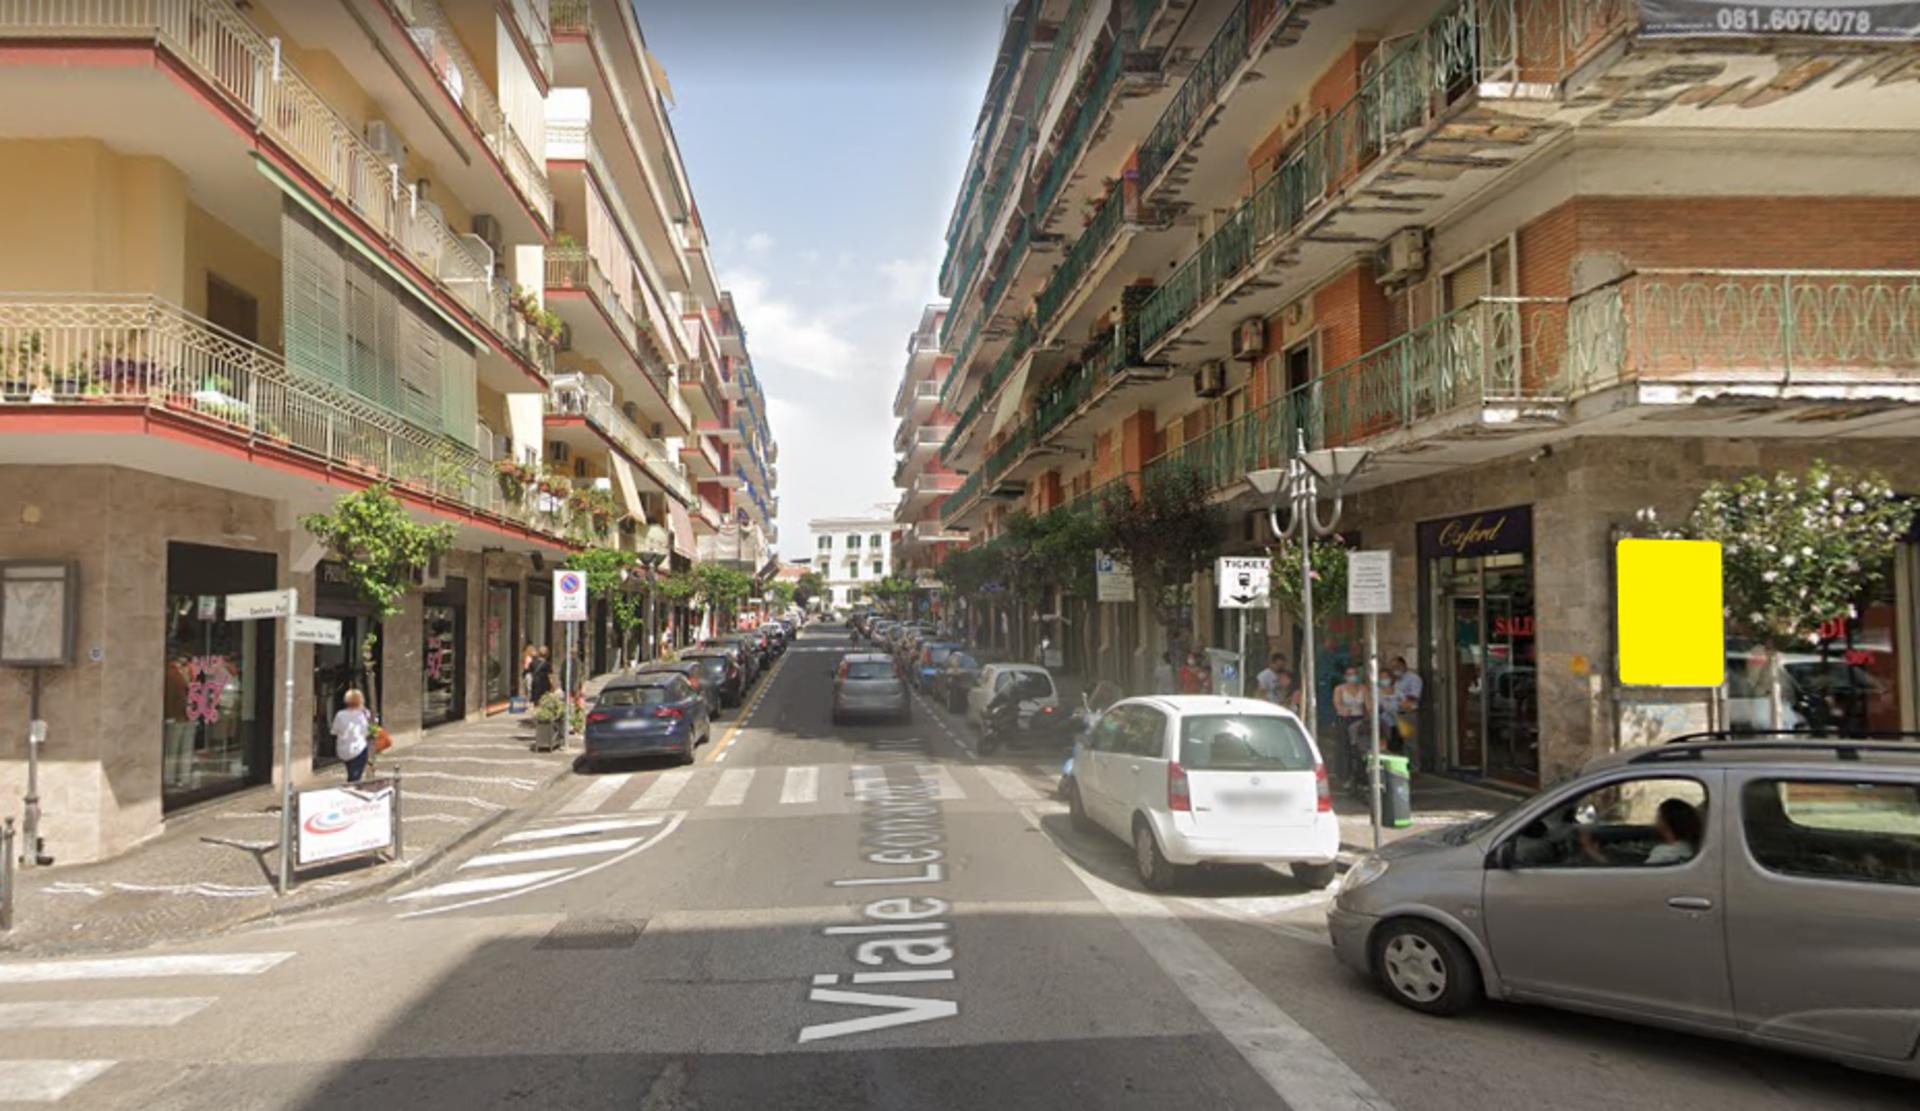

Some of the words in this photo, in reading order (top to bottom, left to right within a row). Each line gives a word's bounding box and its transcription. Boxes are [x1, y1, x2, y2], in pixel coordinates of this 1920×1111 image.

[1716, 7, 1871, 33] 081.6076078
[1438, 515, 1507, 552] Oxford
[1224, 560, 1266, 569] TICKET
